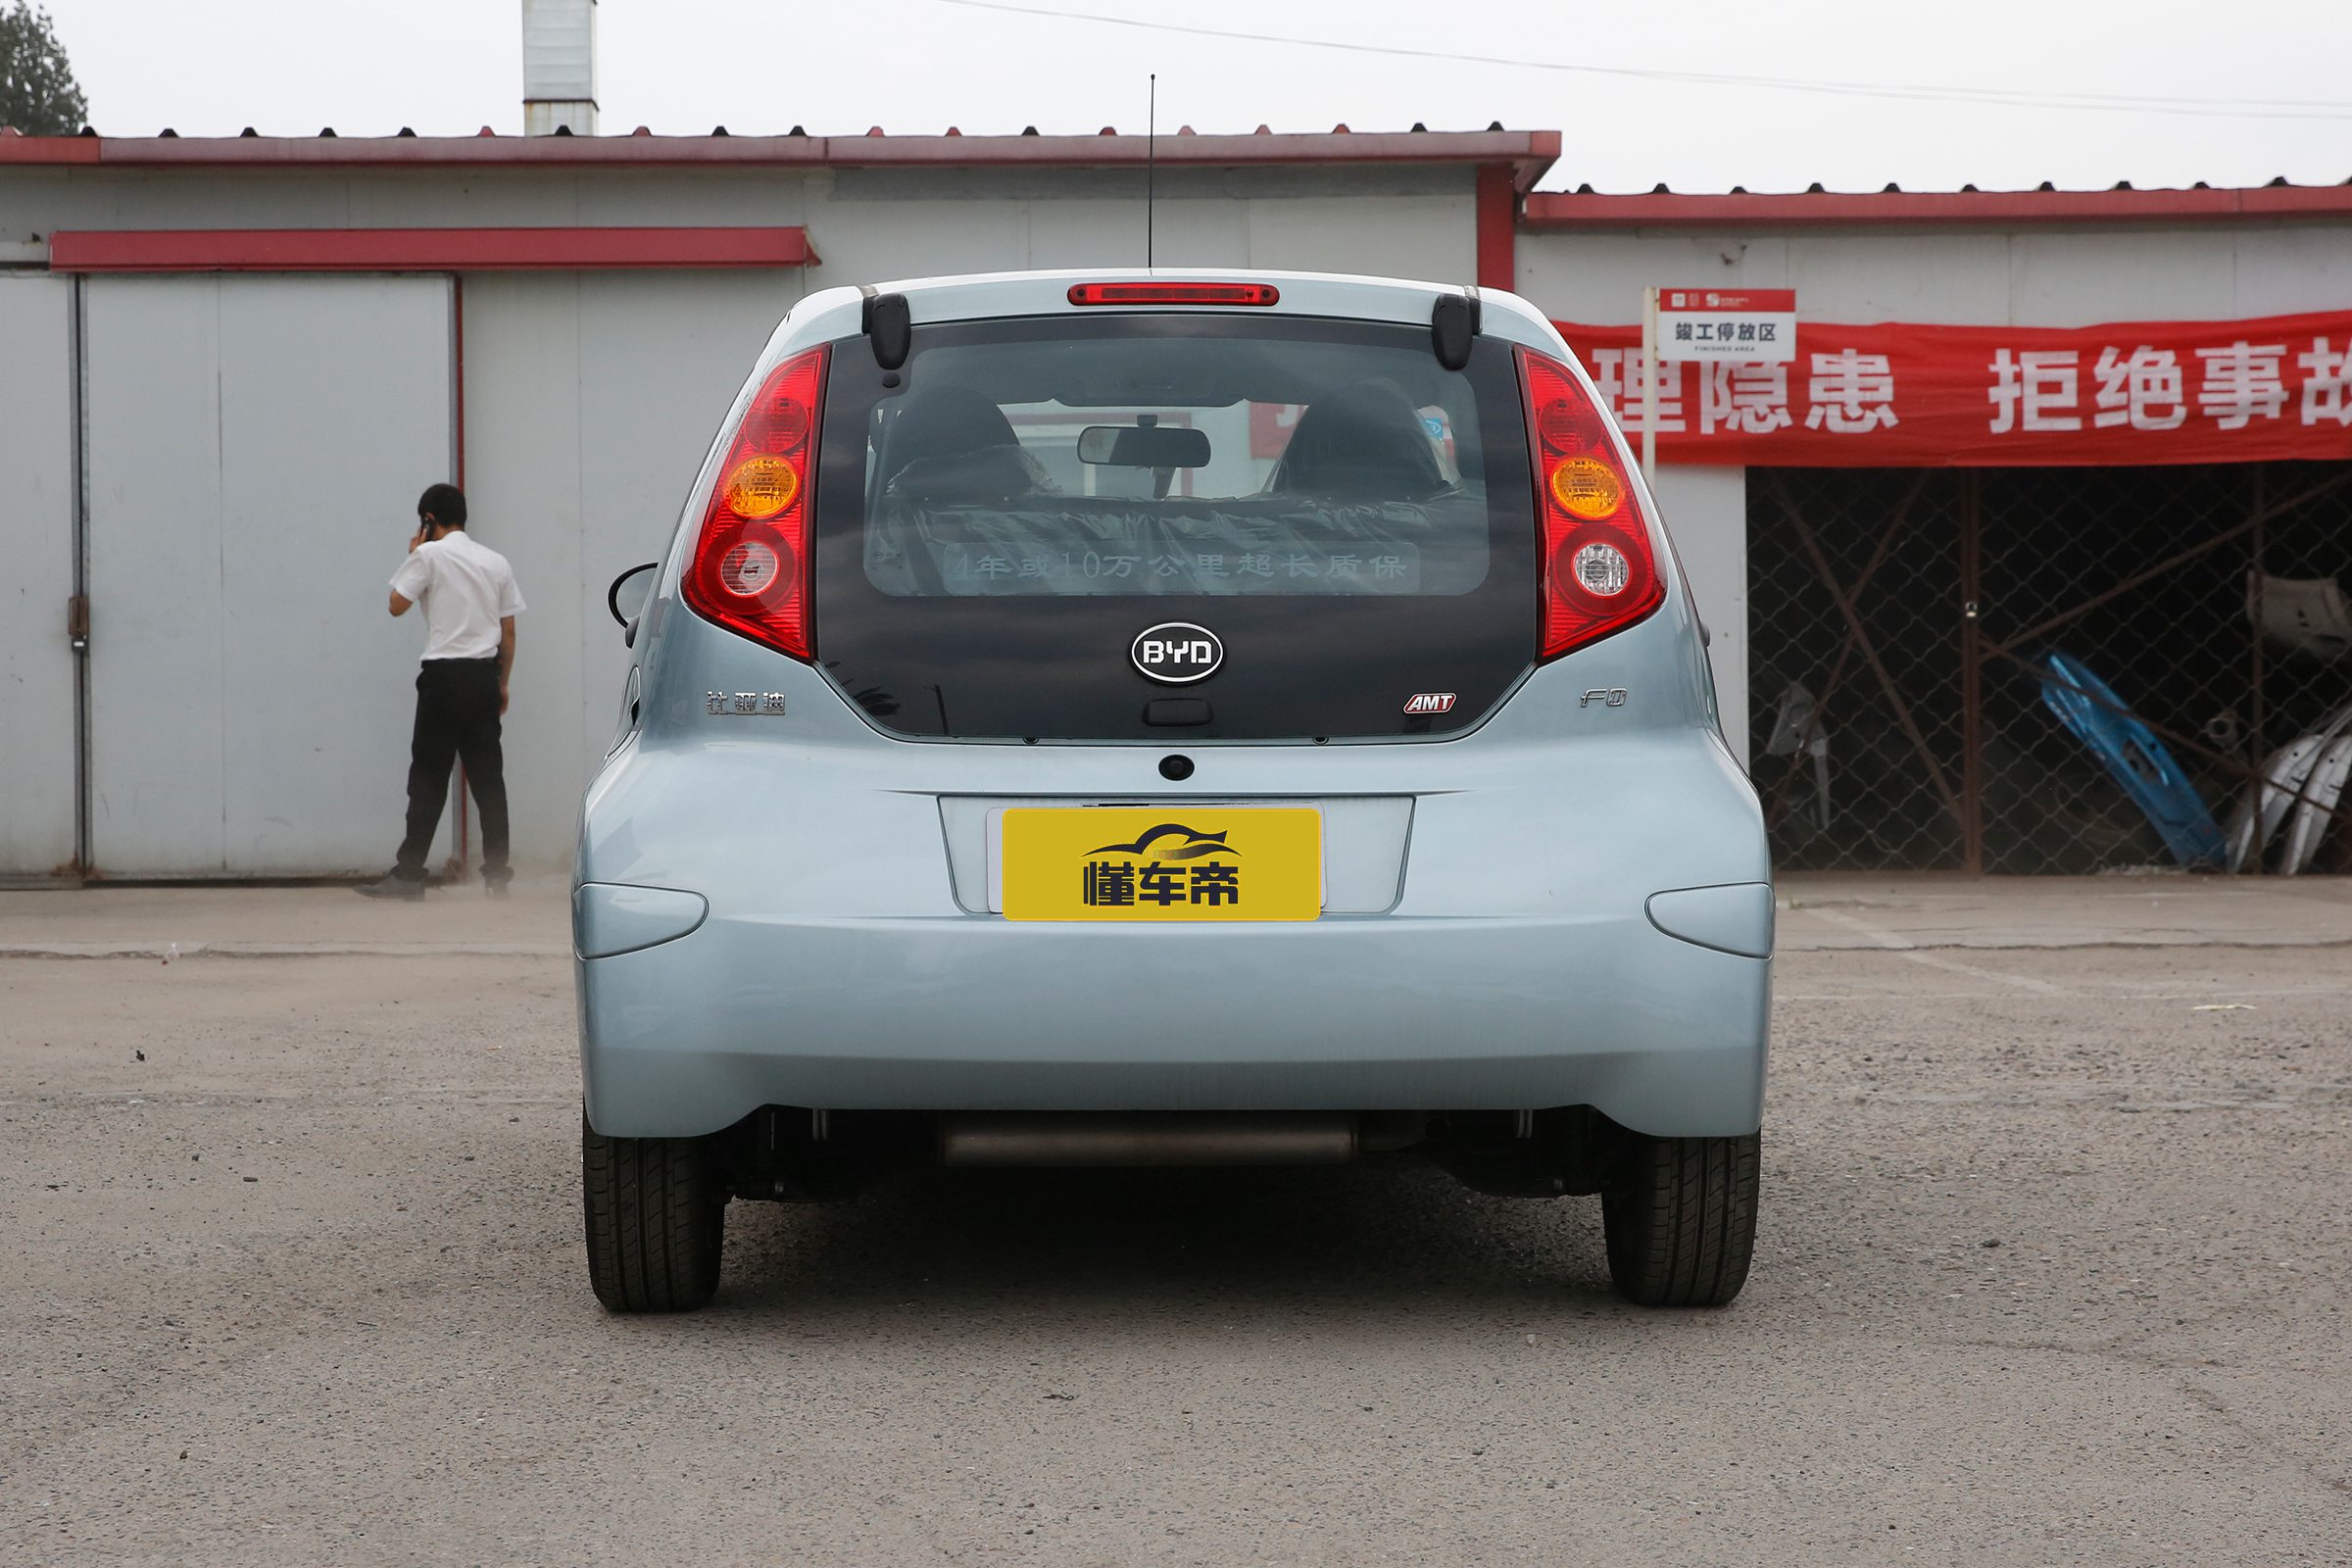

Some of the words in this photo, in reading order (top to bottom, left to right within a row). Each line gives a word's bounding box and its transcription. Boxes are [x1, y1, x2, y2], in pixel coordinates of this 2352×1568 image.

[1675, 321, 1776, 342] 竣工停放区
[1143, 640, 1212, 663] BYD
[1407, 695, 1453, 711] AMT
